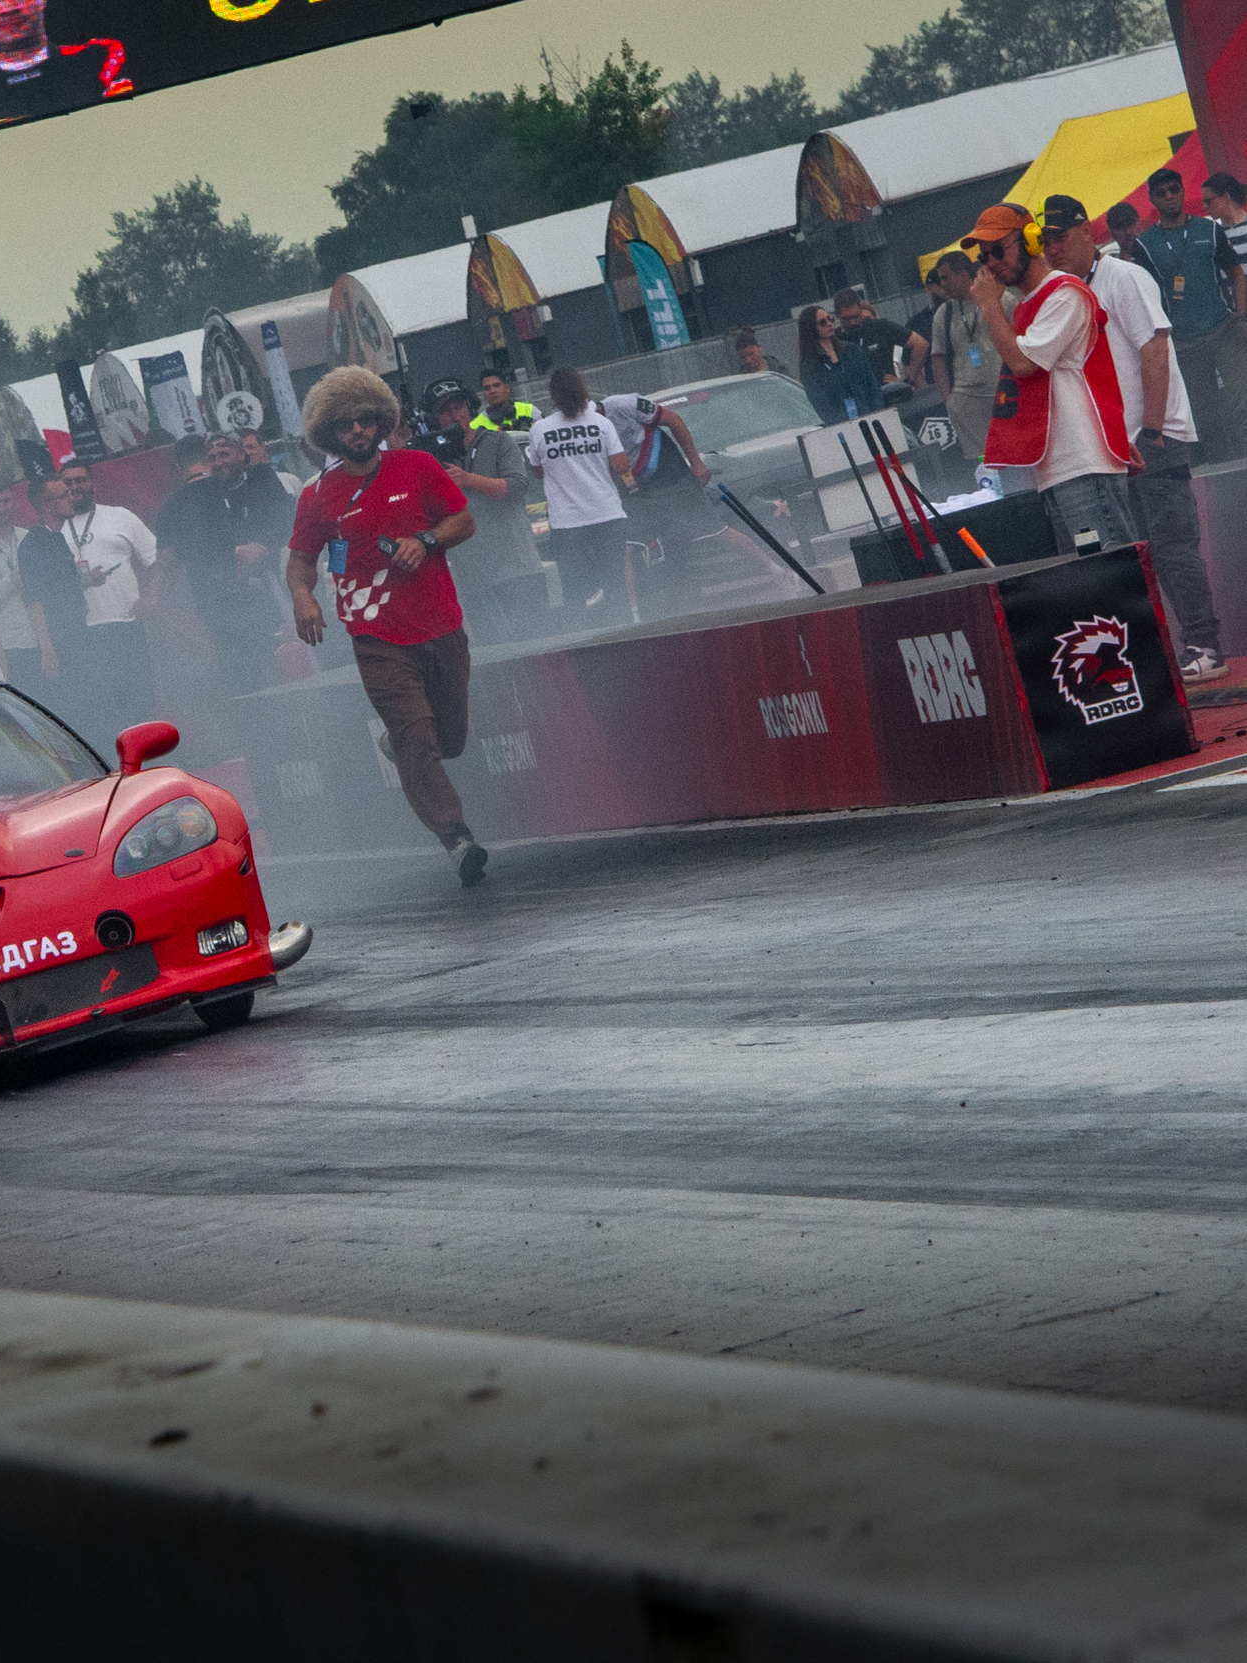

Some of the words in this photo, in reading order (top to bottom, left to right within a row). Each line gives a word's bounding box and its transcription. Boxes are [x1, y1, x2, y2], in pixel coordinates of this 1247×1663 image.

[543, 424, 600, 445] RDRC
[928, 428, 941, 441] 16
[546, 439, 602, 460] Official
[897, 630, 987, 723] RDRC
[758, 691, 829, 739] ROSGONKI
[1085, 696, 1140, 721] RDRC
